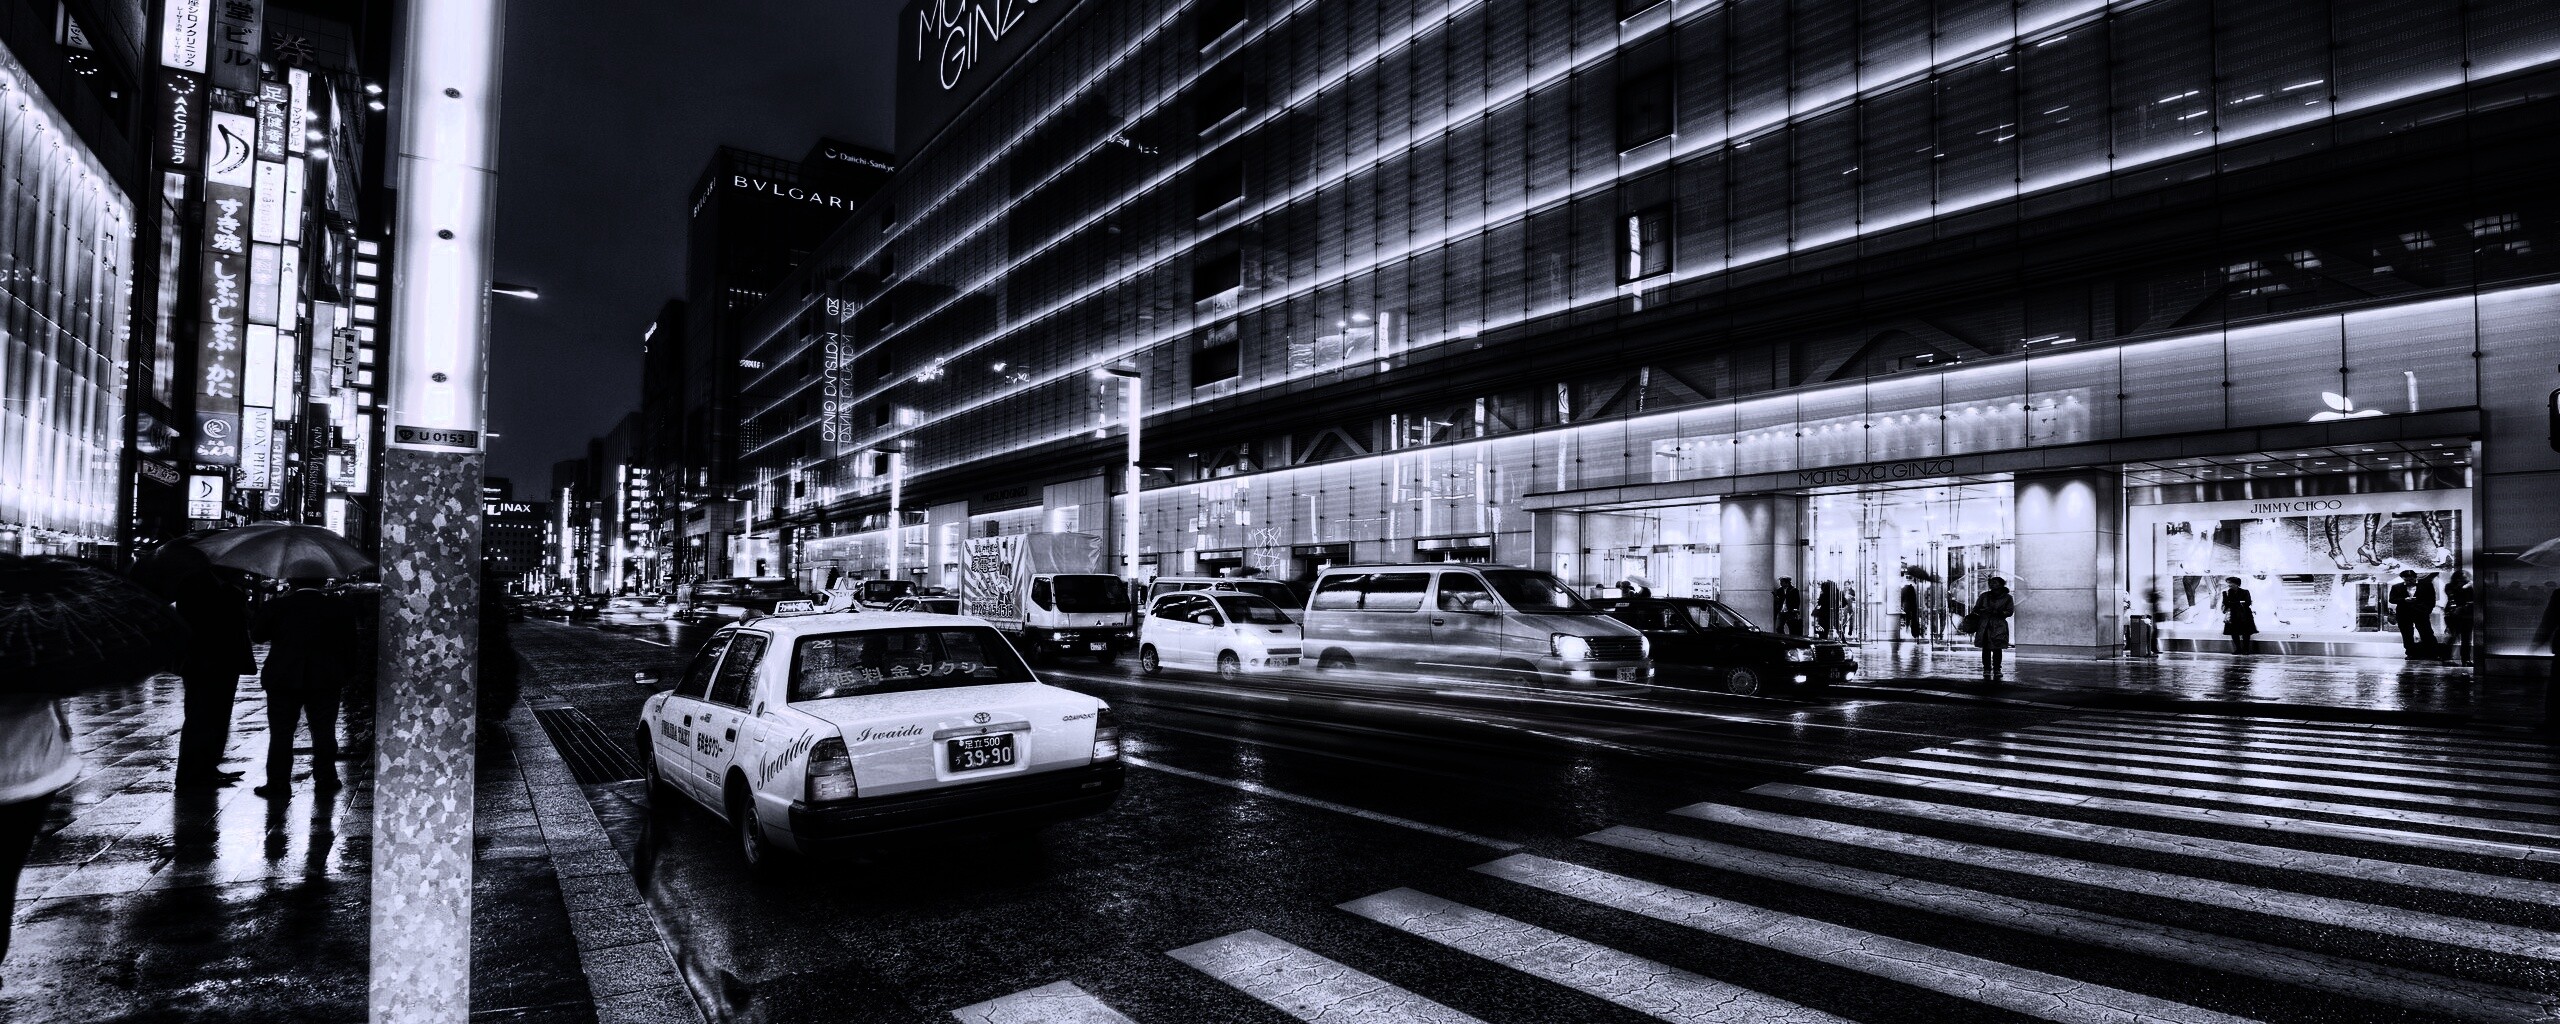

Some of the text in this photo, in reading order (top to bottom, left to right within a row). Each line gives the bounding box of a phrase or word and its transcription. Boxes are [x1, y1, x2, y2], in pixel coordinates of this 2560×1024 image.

[733, 174, 855, 211] BVLGARI
[822, 400, 837, 442] GINZA
[419, 431, 429, 441] U
[433, 431, 465, 444] 0153
[251, 411, 267, 488] MOON PHASE
[1798, 458, 1955, 486] MATSUYA GINZA
[500, 502, 531, 513] INAX
[2250, 499, 2342, 514] JIMMY CHOO
[812, 639, 833, 649] 22
[833, 661, 998, 687] 低料金タクシー
[856, 723, 924, 743] Iwaida
[964, 737, 1000, 750] 足立 500
[756, 727, 815, 791] Iwaida
[963, 746, 1012, 768] 39-90
